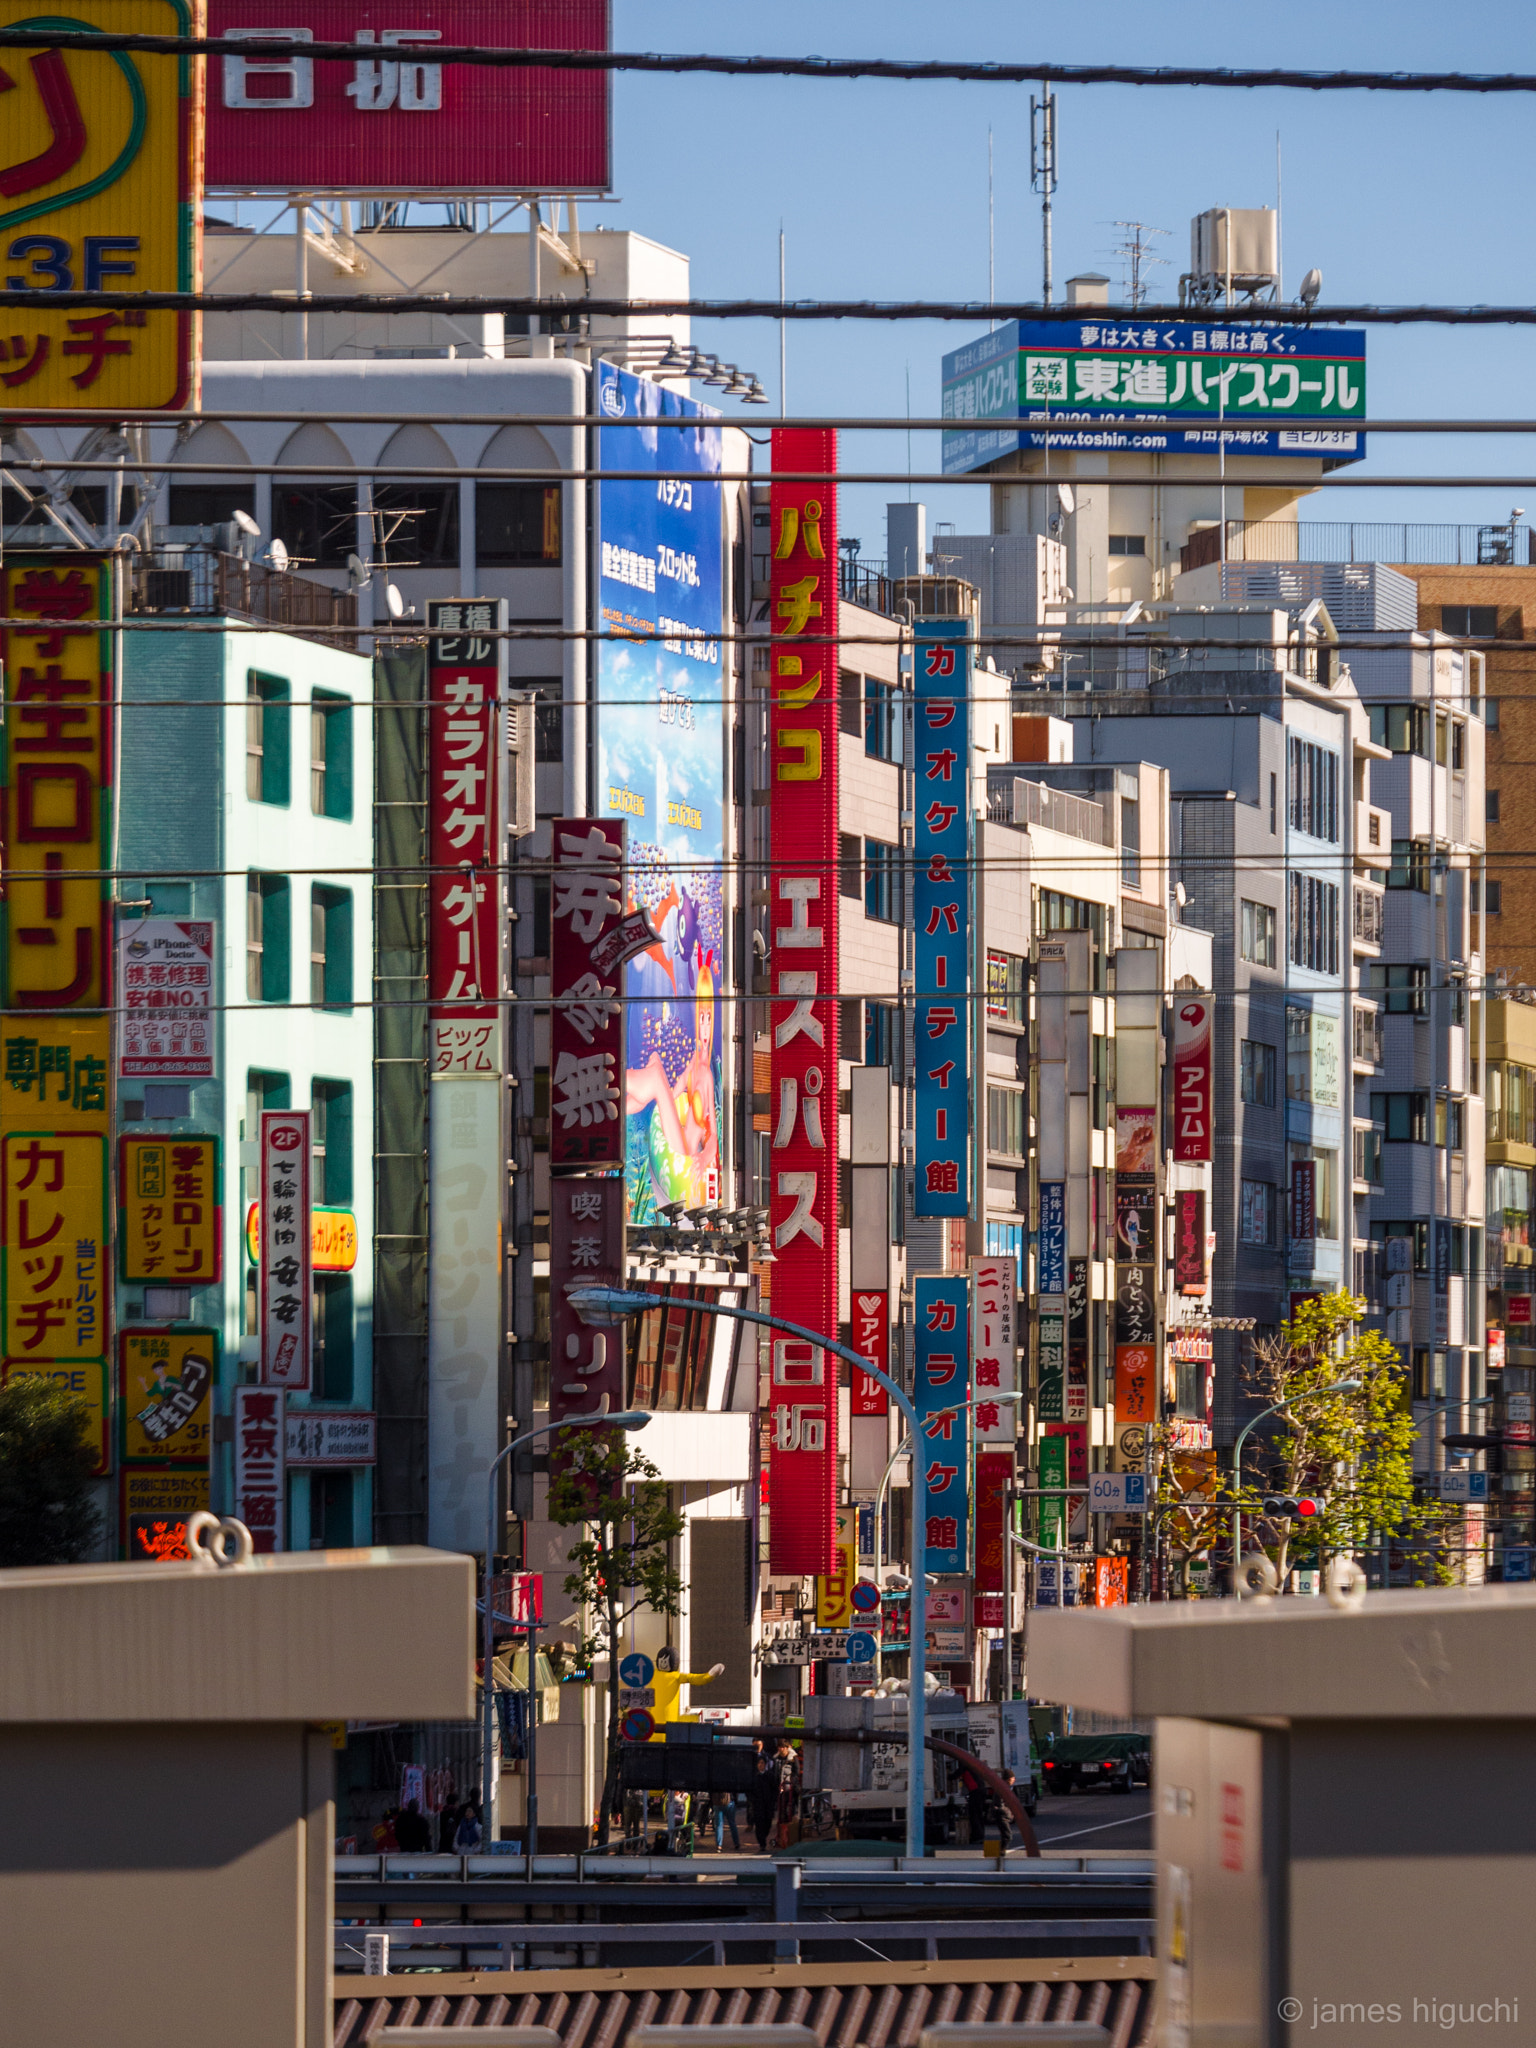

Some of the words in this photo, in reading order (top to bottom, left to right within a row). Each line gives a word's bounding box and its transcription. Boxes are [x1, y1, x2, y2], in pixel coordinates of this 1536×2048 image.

[222, 28, 443, 110] 日拓
[8, 235, 140, 291] 3F
[1080, 326, 1297, 353] 夢は大きく、目標は高く。
[1032, 361, 1063, 378] 大学
[1032, 379, 1063, 396] 受験
[1075, 359, 1359, 410] 東進ハイスクール
[1031, 431, 1167, 449] www.toshin.com
[657, 544, 701, 588] スロットは、
[438, 638, 491, 661] ビル
[774, 500, 826, 780] パチンコ
[14, 570, 93, 1007] 学生ローン
[924, 644, 959, 1195] カラオケ&パーティー館
[153, 938, 192, 950] iPhone
[166, 951, 196, 959] Doctor
[127, 964, 208, 986] 携帯修理
[436, 1026, 493, 1047] ビッグ
[5, 1036, 106, 1111] 専門店
[436, 1051, 493, 1071] タイム
[773, 877, 827, 1248] エスパス
[1181, 1067, 1205, 1138] アコム
[274, 1131, 298, 1146] 2F
[562, 1137, 609, 1159] 2F
[1184, 1144, 1202, 1155] 4F
[142, 1151, 160, 1194] 専門店
[172, 1146, 203, 1273] 学生ローン
[571, 1192, 602, 1267] 喫茶
[15, 1141, 72, 1350] カレッヂ
[1049, 1186, 1063, 1291] 整体リフレッシュ館
[75, 1238, 97, 1347] 当ビル3F
[1001, 1262, 1011, 1344] こだわりの居酒屋
[1127, 1267, 1144, 1342] 肉とパスタ
[1040, 1319, 1064, 1370] 歯科
[1142, 1333, 1153, 1343] 2F
[145, 1359, 207, 1441] 学生ローン
[771, 1338, 826, 1452] 日拓
[863, 1401, 877, 1411] 3F
[1070, 1408, 1086, 1418] 2F
[926, 1299, 958, 1549] カラオケ館
[1094, 1480, 1120, 1497] 60分
[1131, 1478, 1141, 1494] P
[1474, 1475, 1483, 1488] P
[853, 1641, 865, 1659] P
[861, 1650, 870, 1659] 60
